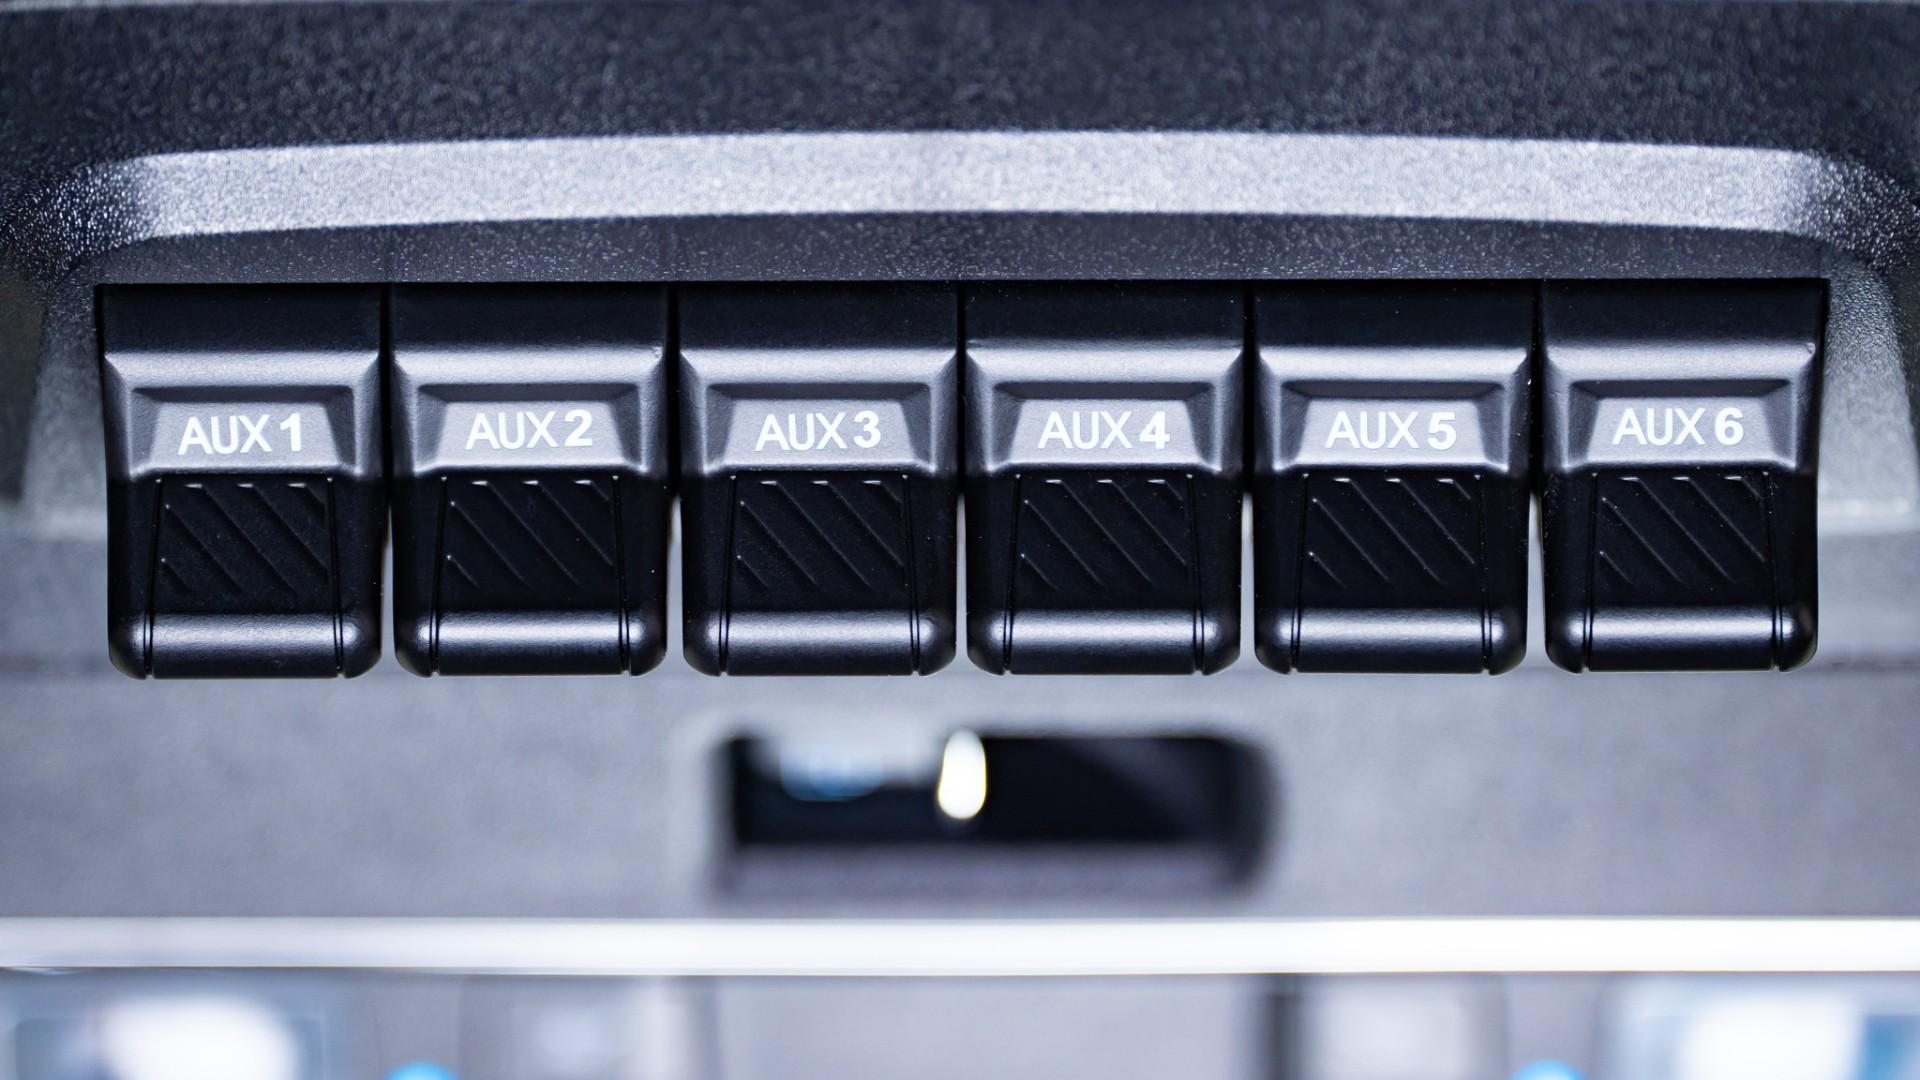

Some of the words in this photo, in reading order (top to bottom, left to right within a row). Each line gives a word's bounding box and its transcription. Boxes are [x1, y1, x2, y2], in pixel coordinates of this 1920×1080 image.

[177, 413, 271, 455] AUX
[279, 412, 302, 452] 1
[465, 411, 559, 450] AUX
[563, 408, 593, 446] 2
[754, 412, 848, 451] AUX
[853, 410, 881, 448] 3
[1037, 410, 1132, 449] AUX
[1139, 410, 1170, 450] 4
[1325, 410, 1419, 450] AUX
[1427, 410, 1457, 450] 5
[1611, 407, 1705, 446] AUX
[1714, 407, 1744, 445] 6
